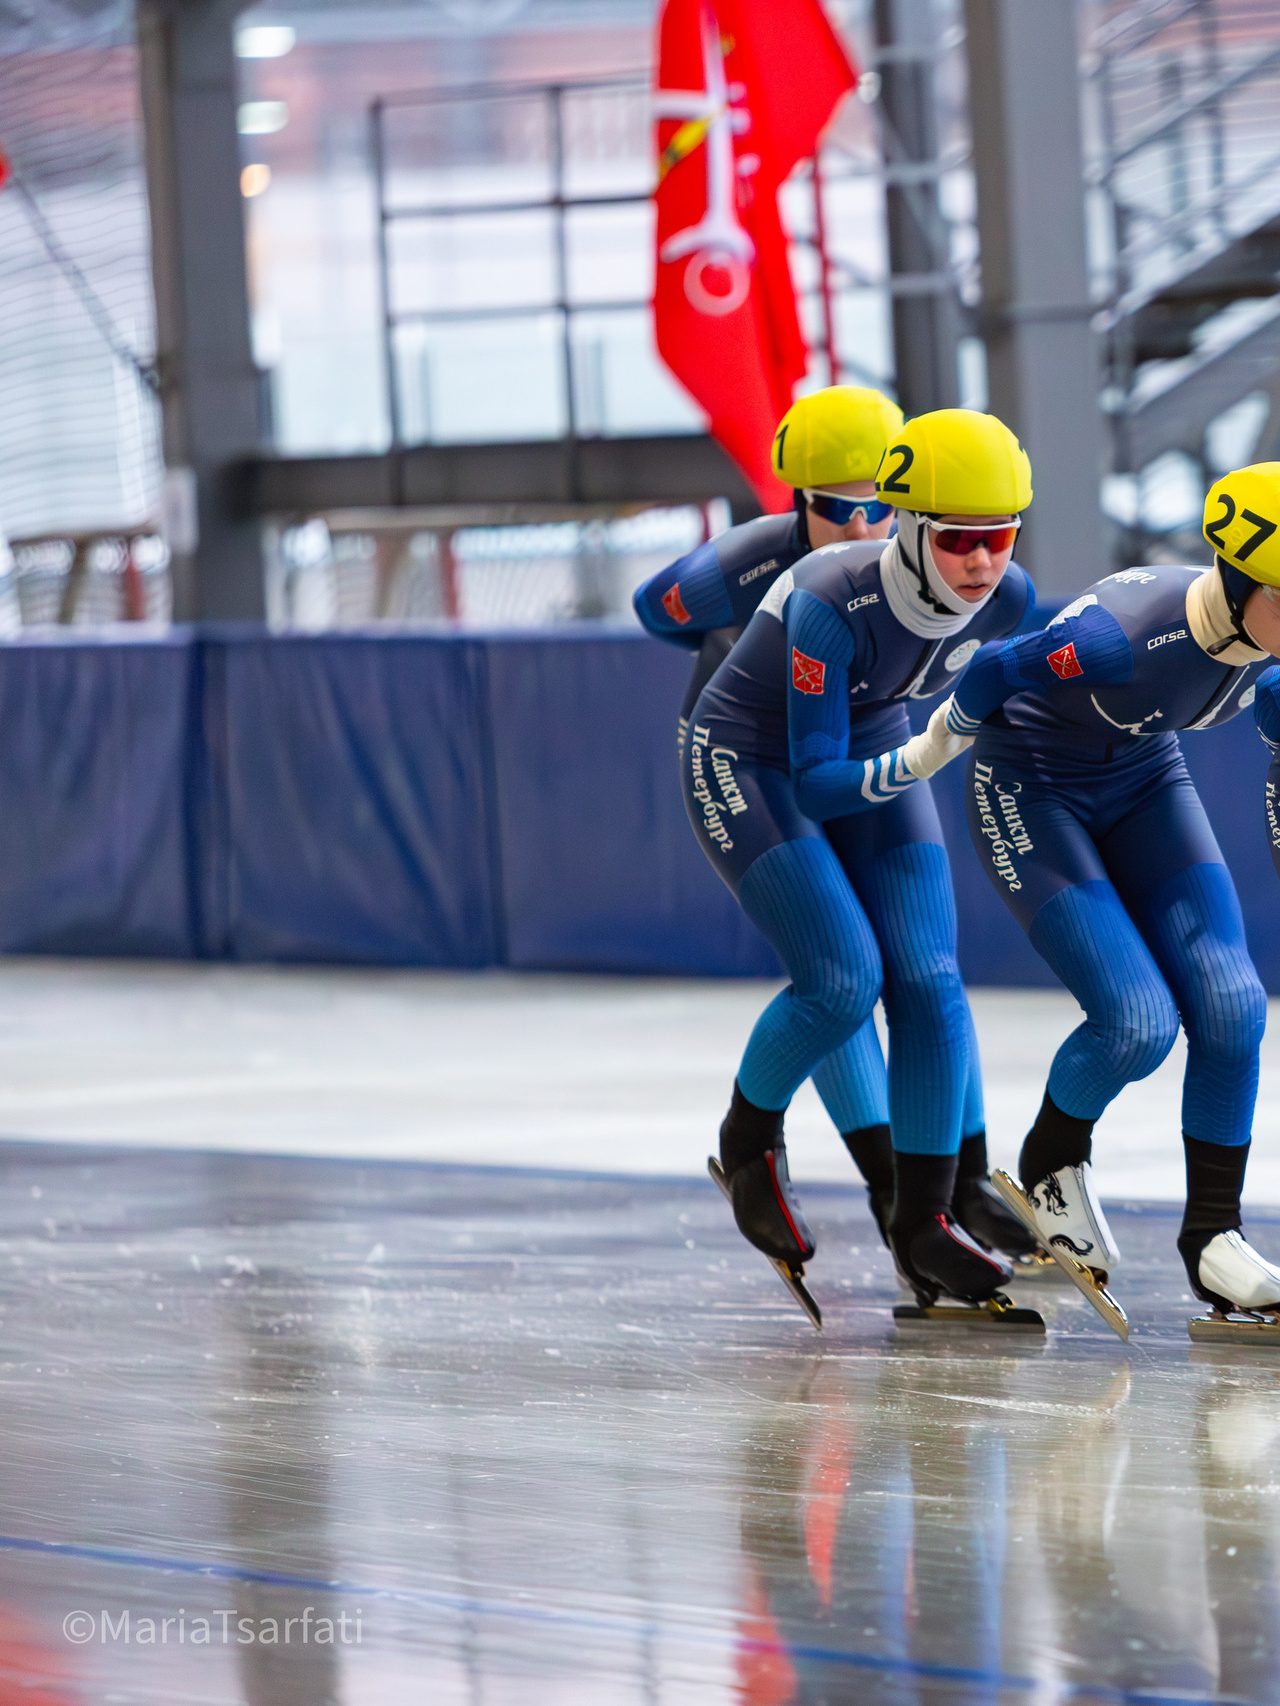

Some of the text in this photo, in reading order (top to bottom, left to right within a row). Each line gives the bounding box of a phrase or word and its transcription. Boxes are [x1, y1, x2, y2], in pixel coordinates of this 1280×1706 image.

[1206, 493, 1278, 562] 27
[1147, 629, 1189, 650] corsa
[690, 723, 734, 853] Петербург
[710, 747, 748, 816] Санкт
[974, 759, 1023, 893] Петербург
[994, 781, 1034, 855] Санкт
